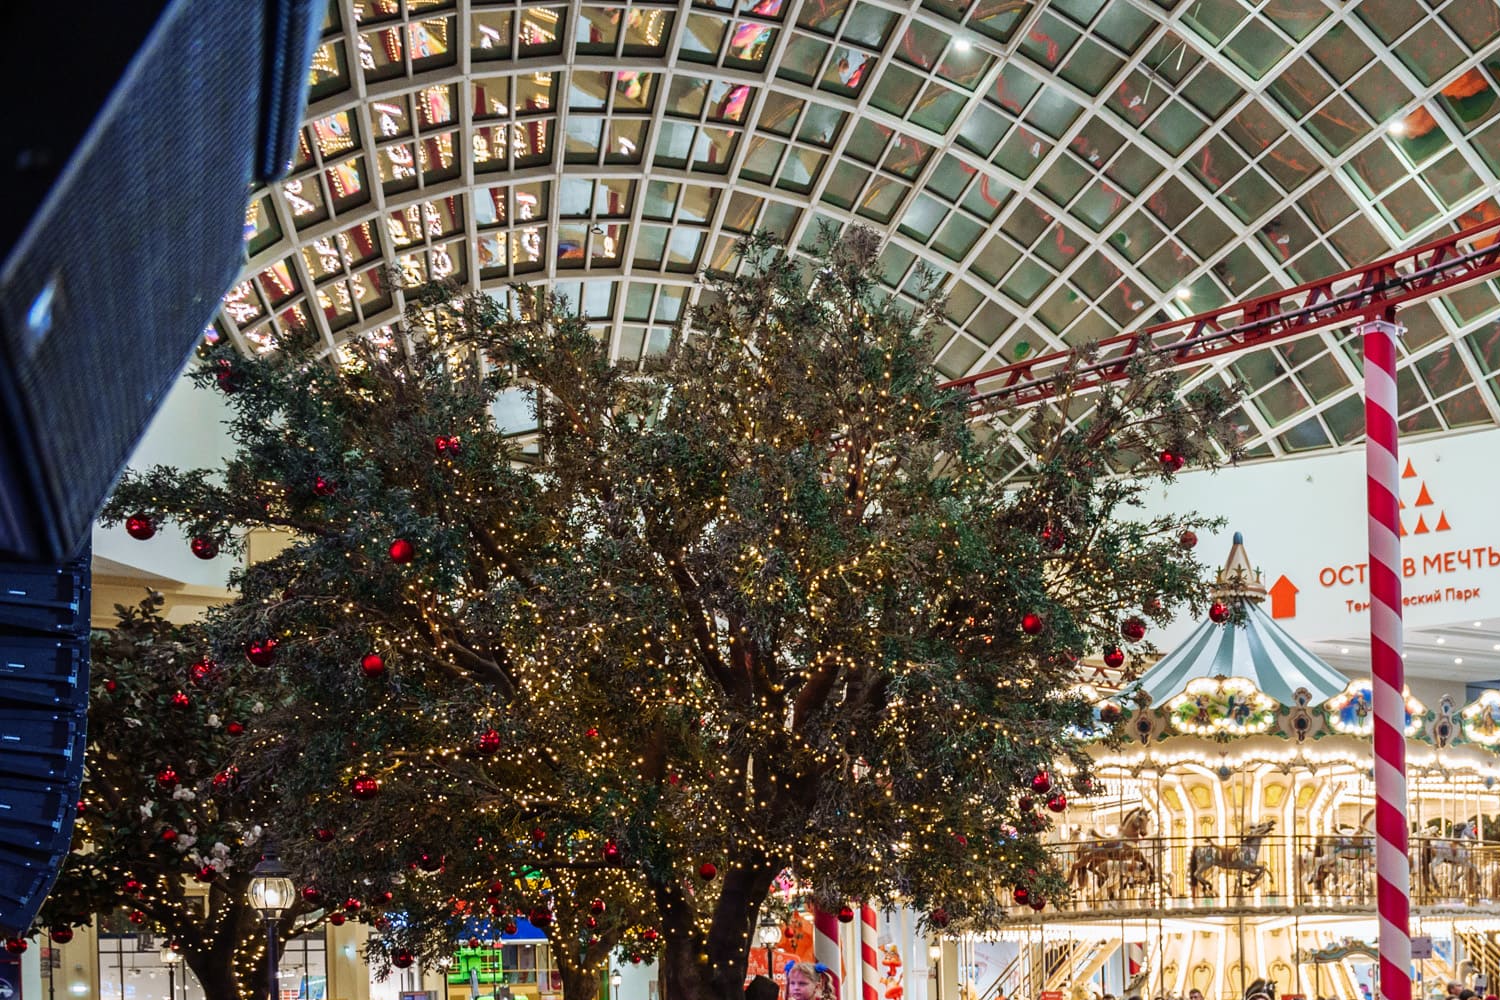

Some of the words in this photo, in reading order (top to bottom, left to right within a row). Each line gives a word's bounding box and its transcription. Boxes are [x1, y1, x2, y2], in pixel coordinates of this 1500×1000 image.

[1319, 557, 1416, 588] ОСТВ
[1346, 590, 1442, 613] Темеский
[1446, 587, 1481, 602] Парк
